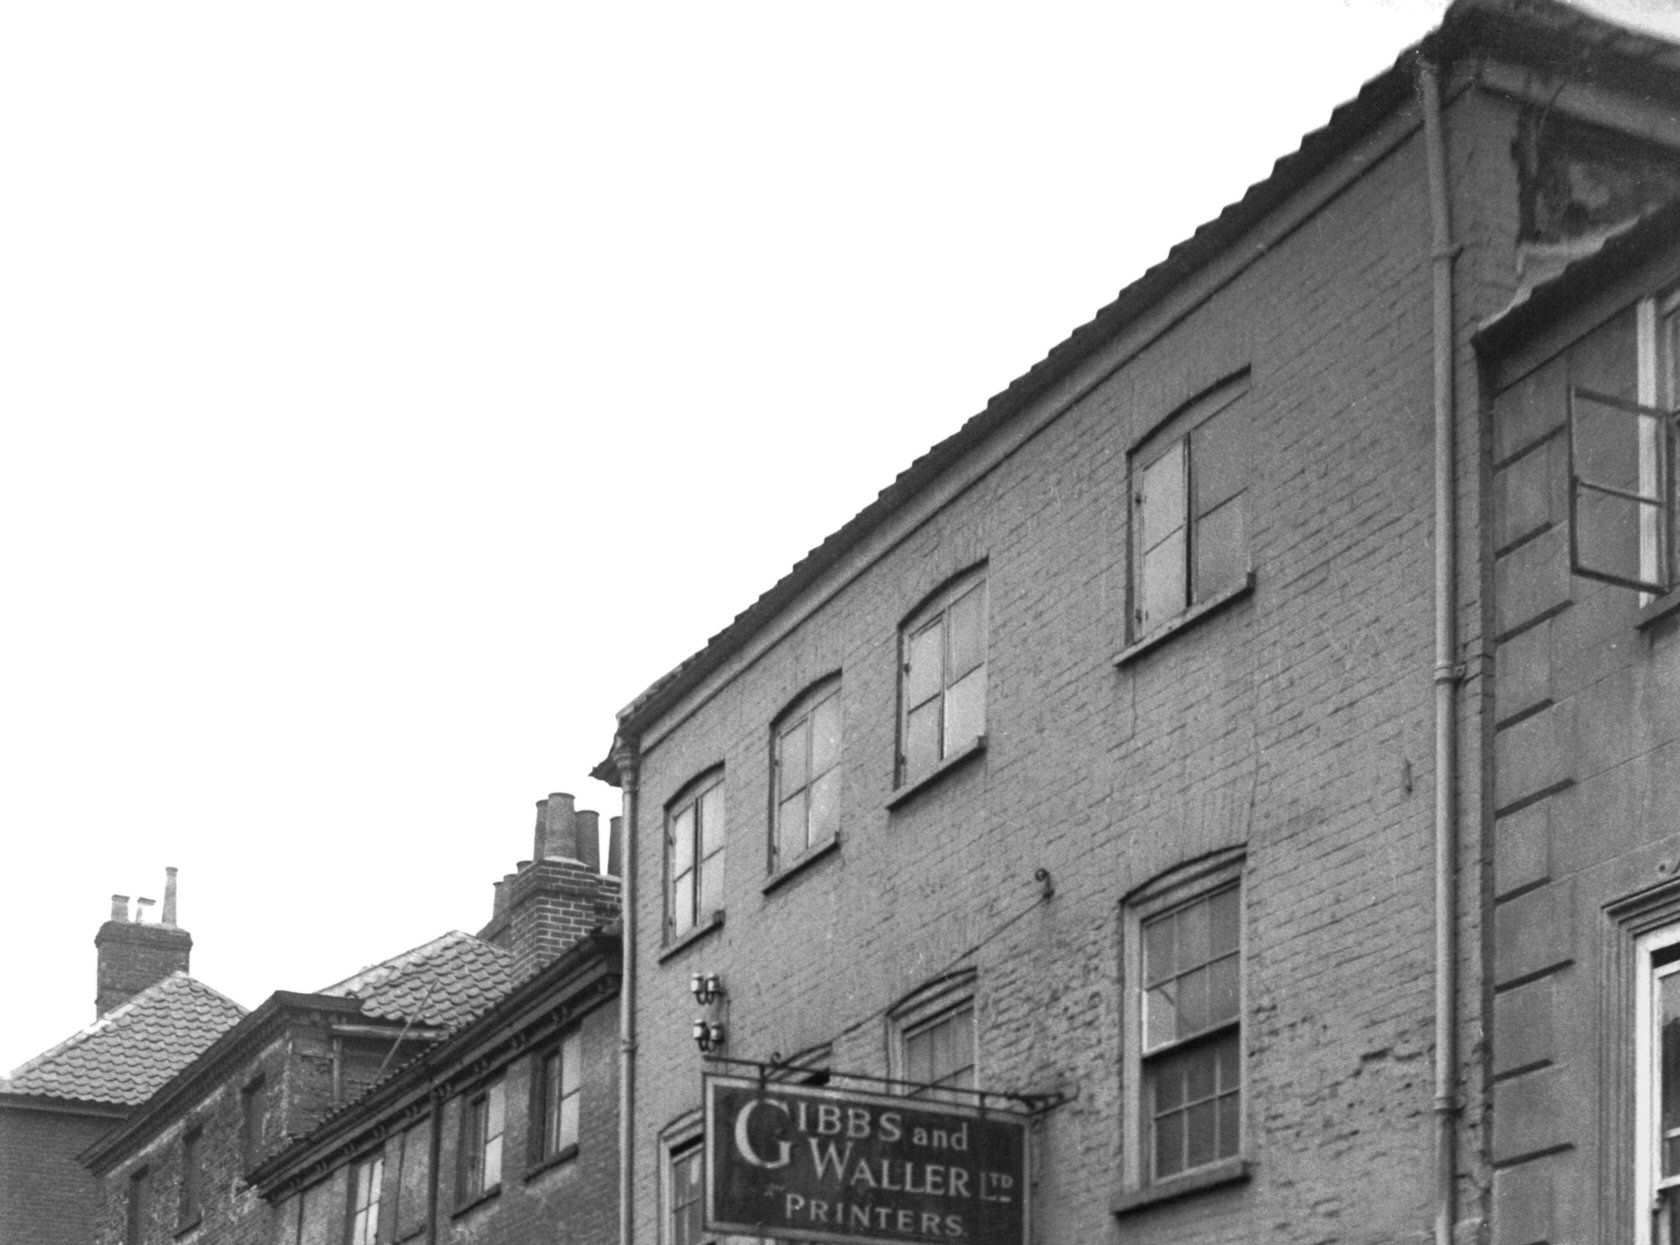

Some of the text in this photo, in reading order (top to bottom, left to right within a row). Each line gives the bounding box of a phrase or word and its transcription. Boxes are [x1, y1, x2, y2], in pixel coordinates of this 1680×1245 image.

[735, 1099, 969, 1169] GIBBS and
[809, 1137, 1014, 1203] WALLER LTD
